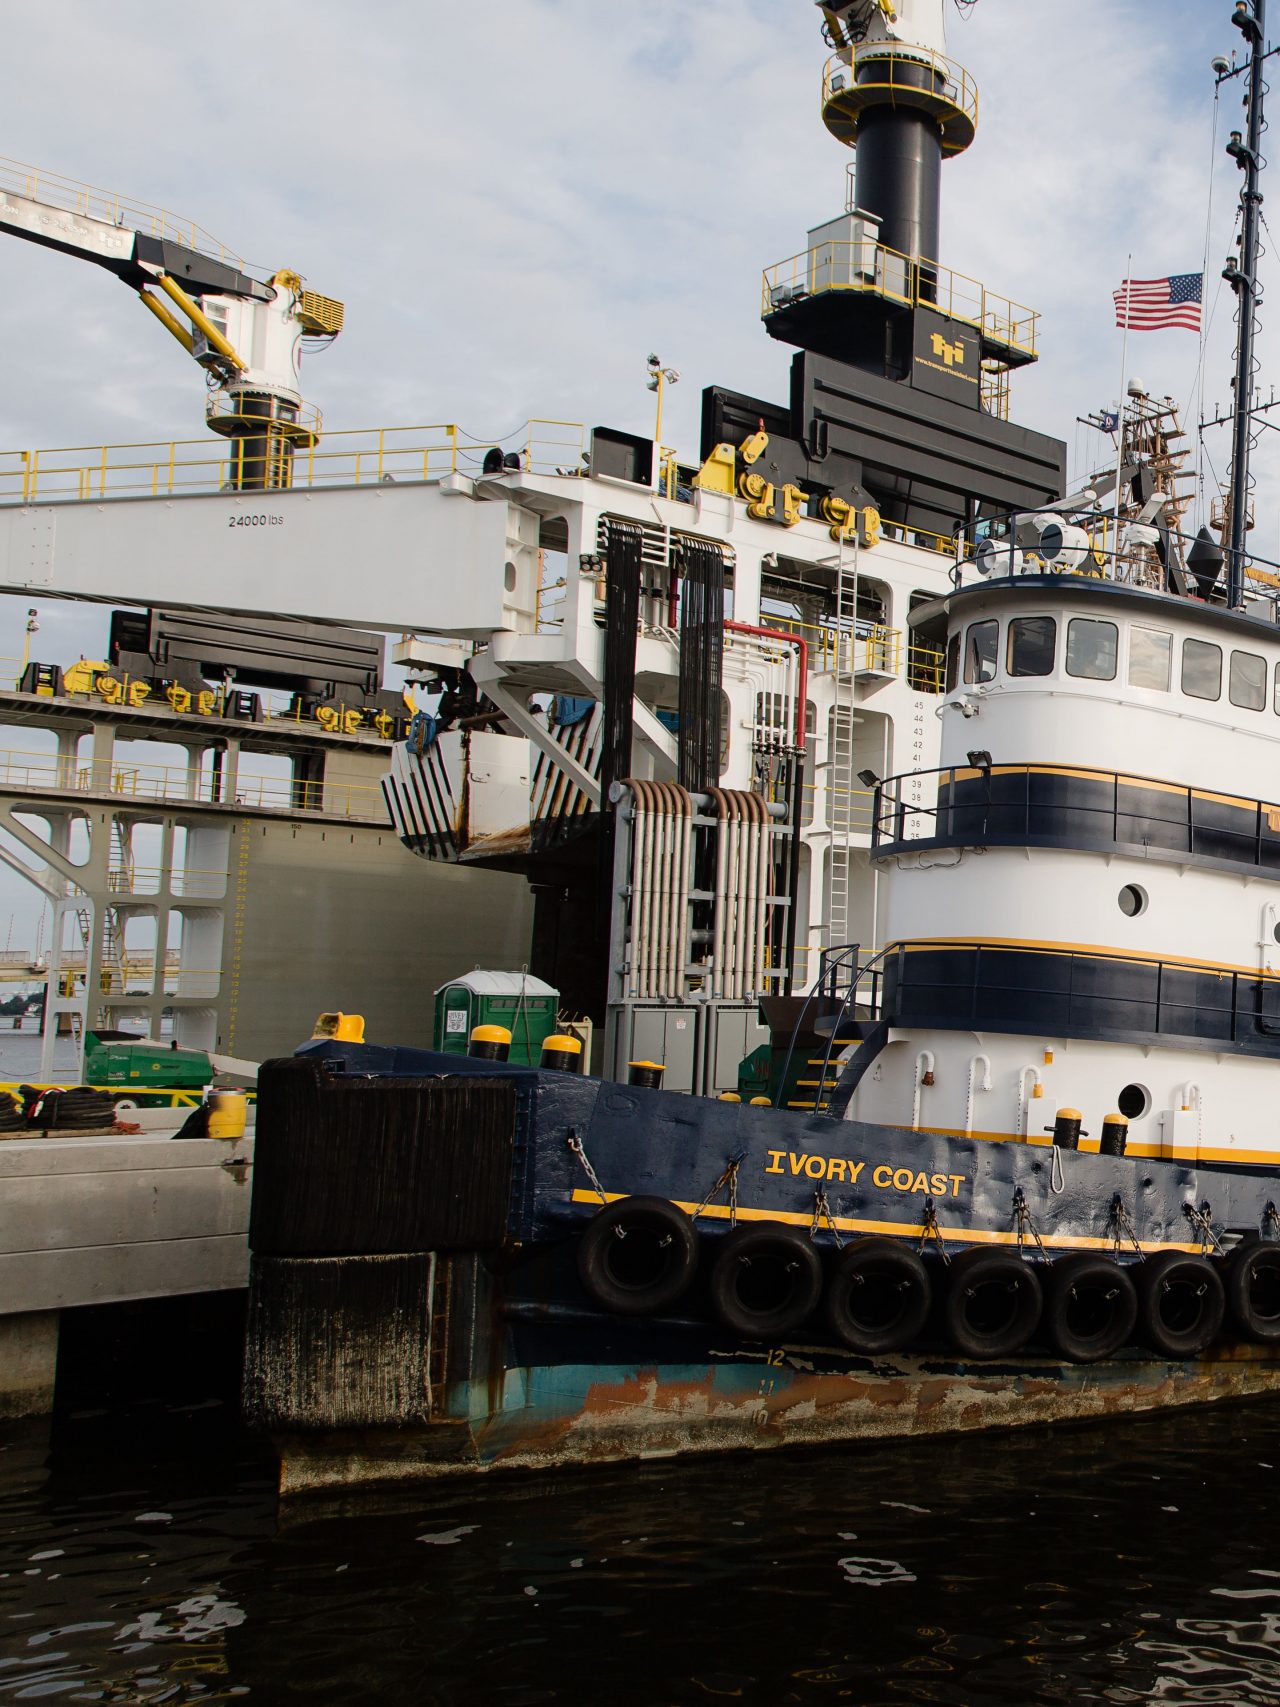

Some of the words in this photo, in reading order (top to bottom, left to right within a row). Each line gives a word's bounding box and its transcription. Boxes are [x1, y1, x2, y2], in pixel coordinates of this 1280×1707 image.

[228, 514, 267, 527] 24000
[268, 514, 284, 525] lbs
[914, 701, 924, 710] 45
[914, 714, 923, 722] 44
[913, 728, 923, 736] 43
[913, 741, 923, 749] 42
[911, 780, 922, 788] 39
[911, 793, 921, 801] 38
[910, 819, 921, 828] 36
[765, 1149, 865, 1184] IVORY
[872, 1165, 966, 1198] COAST
[767, 1348, 785, 1366] 12
